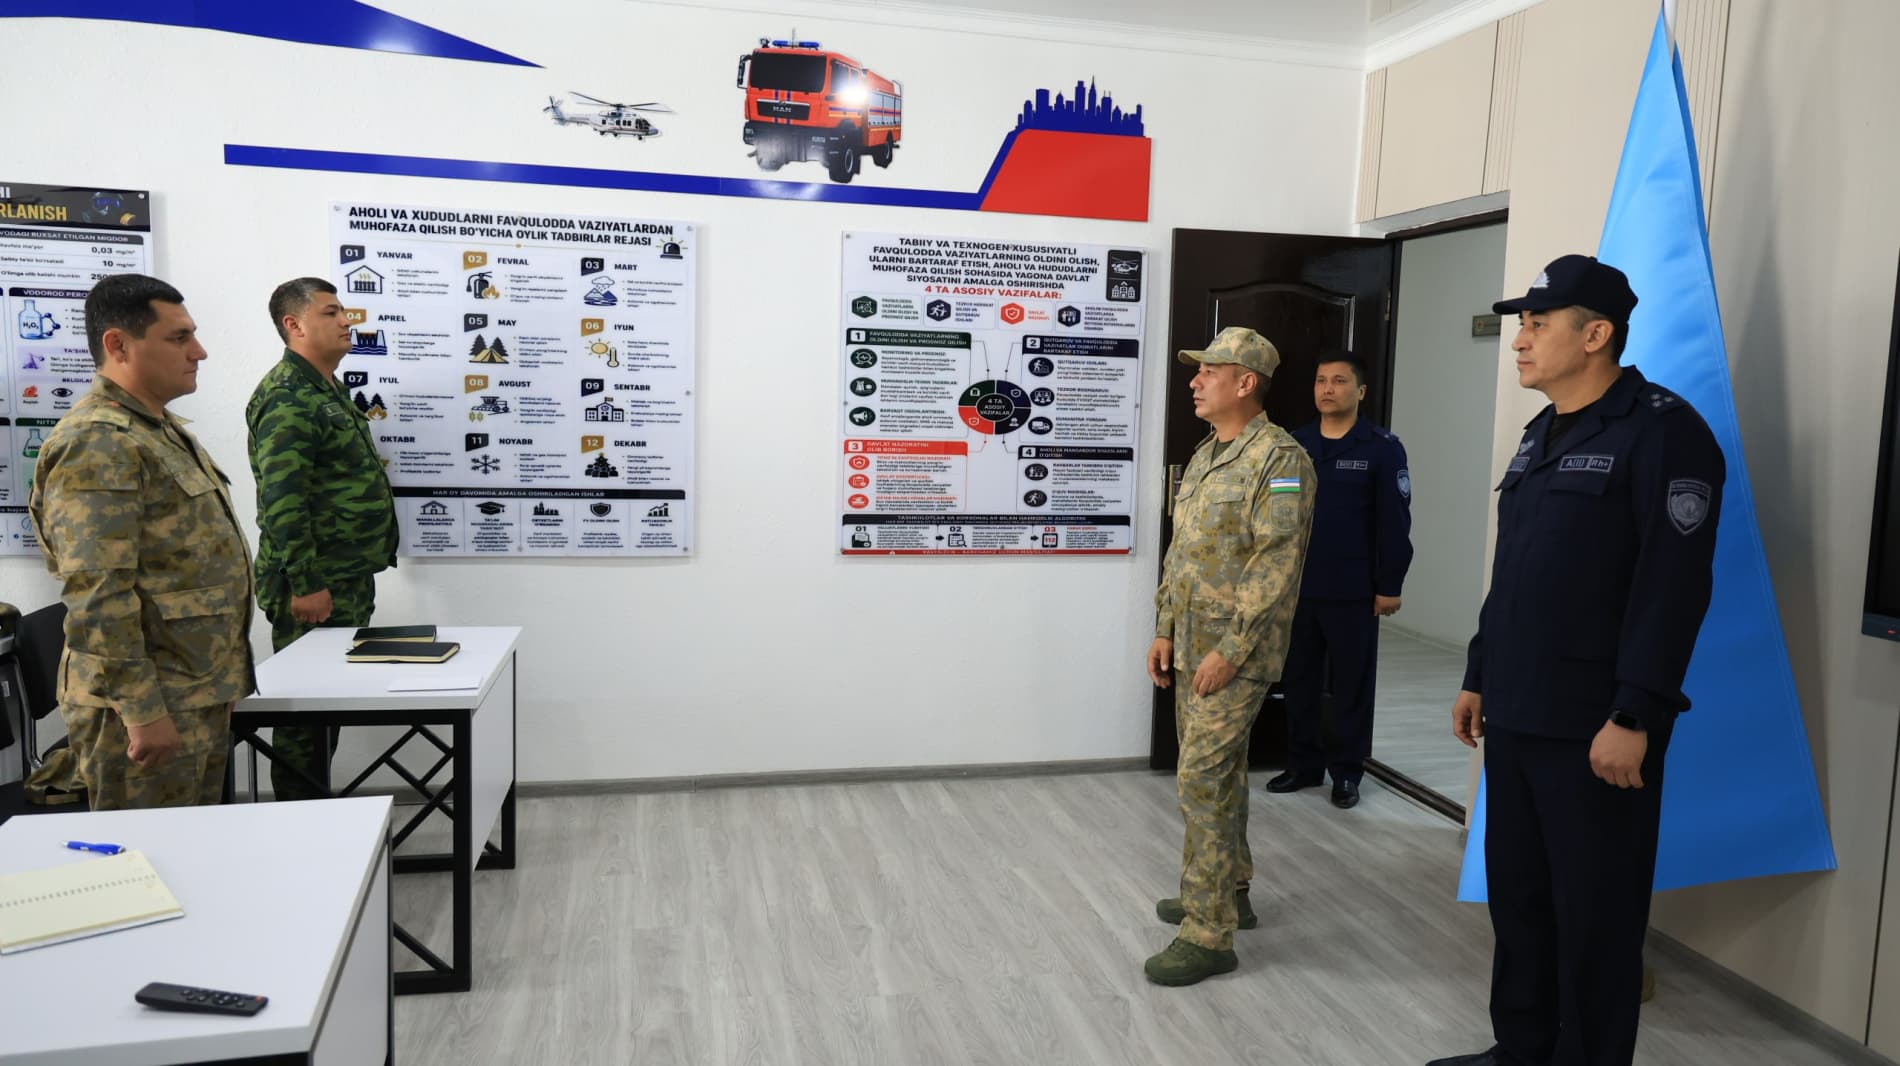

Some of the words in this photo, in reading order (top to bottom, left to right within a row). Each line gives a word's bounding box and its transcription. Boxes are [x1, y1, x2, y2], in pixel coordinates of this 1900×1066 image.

[0, 203, 67, 221] RLANISH
[349, 206, 387, 218] AHOLI
[391, 209, 408, 220] VA
[412, 210, 493, 225] XUDUDLARNI
[497, 216, 575, 229] FAVQULODDA
[578, 220, 673, 235] VAZIYATLARDAN
[349, 220, 416, 233] MUHOFAZA
[419, 224, 456, 235] QILISH
[459, 226, 513, 238] BO'YICHA
[516, 230, 548, 241] OYLIK
[550, 232, 611, 244] TADBIRLAR
[614, 236, 651, 246] REJASI
[91, 246, 113, 254] 0,03
[899, 238, 933, 247] TABIIY
[953, 241, 1010, 251] TEXNOGEN
[1011, 244, 1077, 255] XUSUSIYATLI
[345, 249, 359, 257] 01
[377, 251, 412, 259] YANVAR
[873, 246, 942, 257] FAVQULODDA
[945, 250, 1031, 261] VAZIYATLARNING
[1033, 255, 1066, 264] OLDINI
[1068, 257, 1100, 266] OLISH,
[468, 255, 482, 264] 02
[497, 258, 529, 266] FEVRAL
[585, 261, 600, 269] 03
[869, 255, 906, 264] ULARNI
[908, 257, 959, 267] BARTARAF
[961, 259, 991, 269] ETISH,
[993, 262, 1021, 270] AHOLI
[1038, 264, 1098, 274] HUDUDLARNI
[872, 264, 927, 274] MUHOFAZA
[930, 267, 962, 276] QILISH
[964, 269, 1013, 278] SOHASIDA
[1015, 272, 1053, 280] YAGONA
[1056, 274, 1090, 282] DAVLAT
[907, 275, 960, 284] SIYOSATINI
[963, 278, 1004, 286] AMALGA
[1006, 280, 1064, 289] OSHIRISHDA
[935, 286, 949, 294] TA
[953, 287, 994, 296] ASOSIY
[998, 290, 1062, 299] VAZIFALAR:
[347, 312, 361, 320] 04
[468, 317, 483, 325] 05
[585, 322, 600, 330] 06
[1030, 339, 1037, 347] 2
[348, 375, 363, 383] 07
[585, 382, 600, 390] 09
[472, 437, 482, 445] 11
[587, 439, 599, 447] 12
